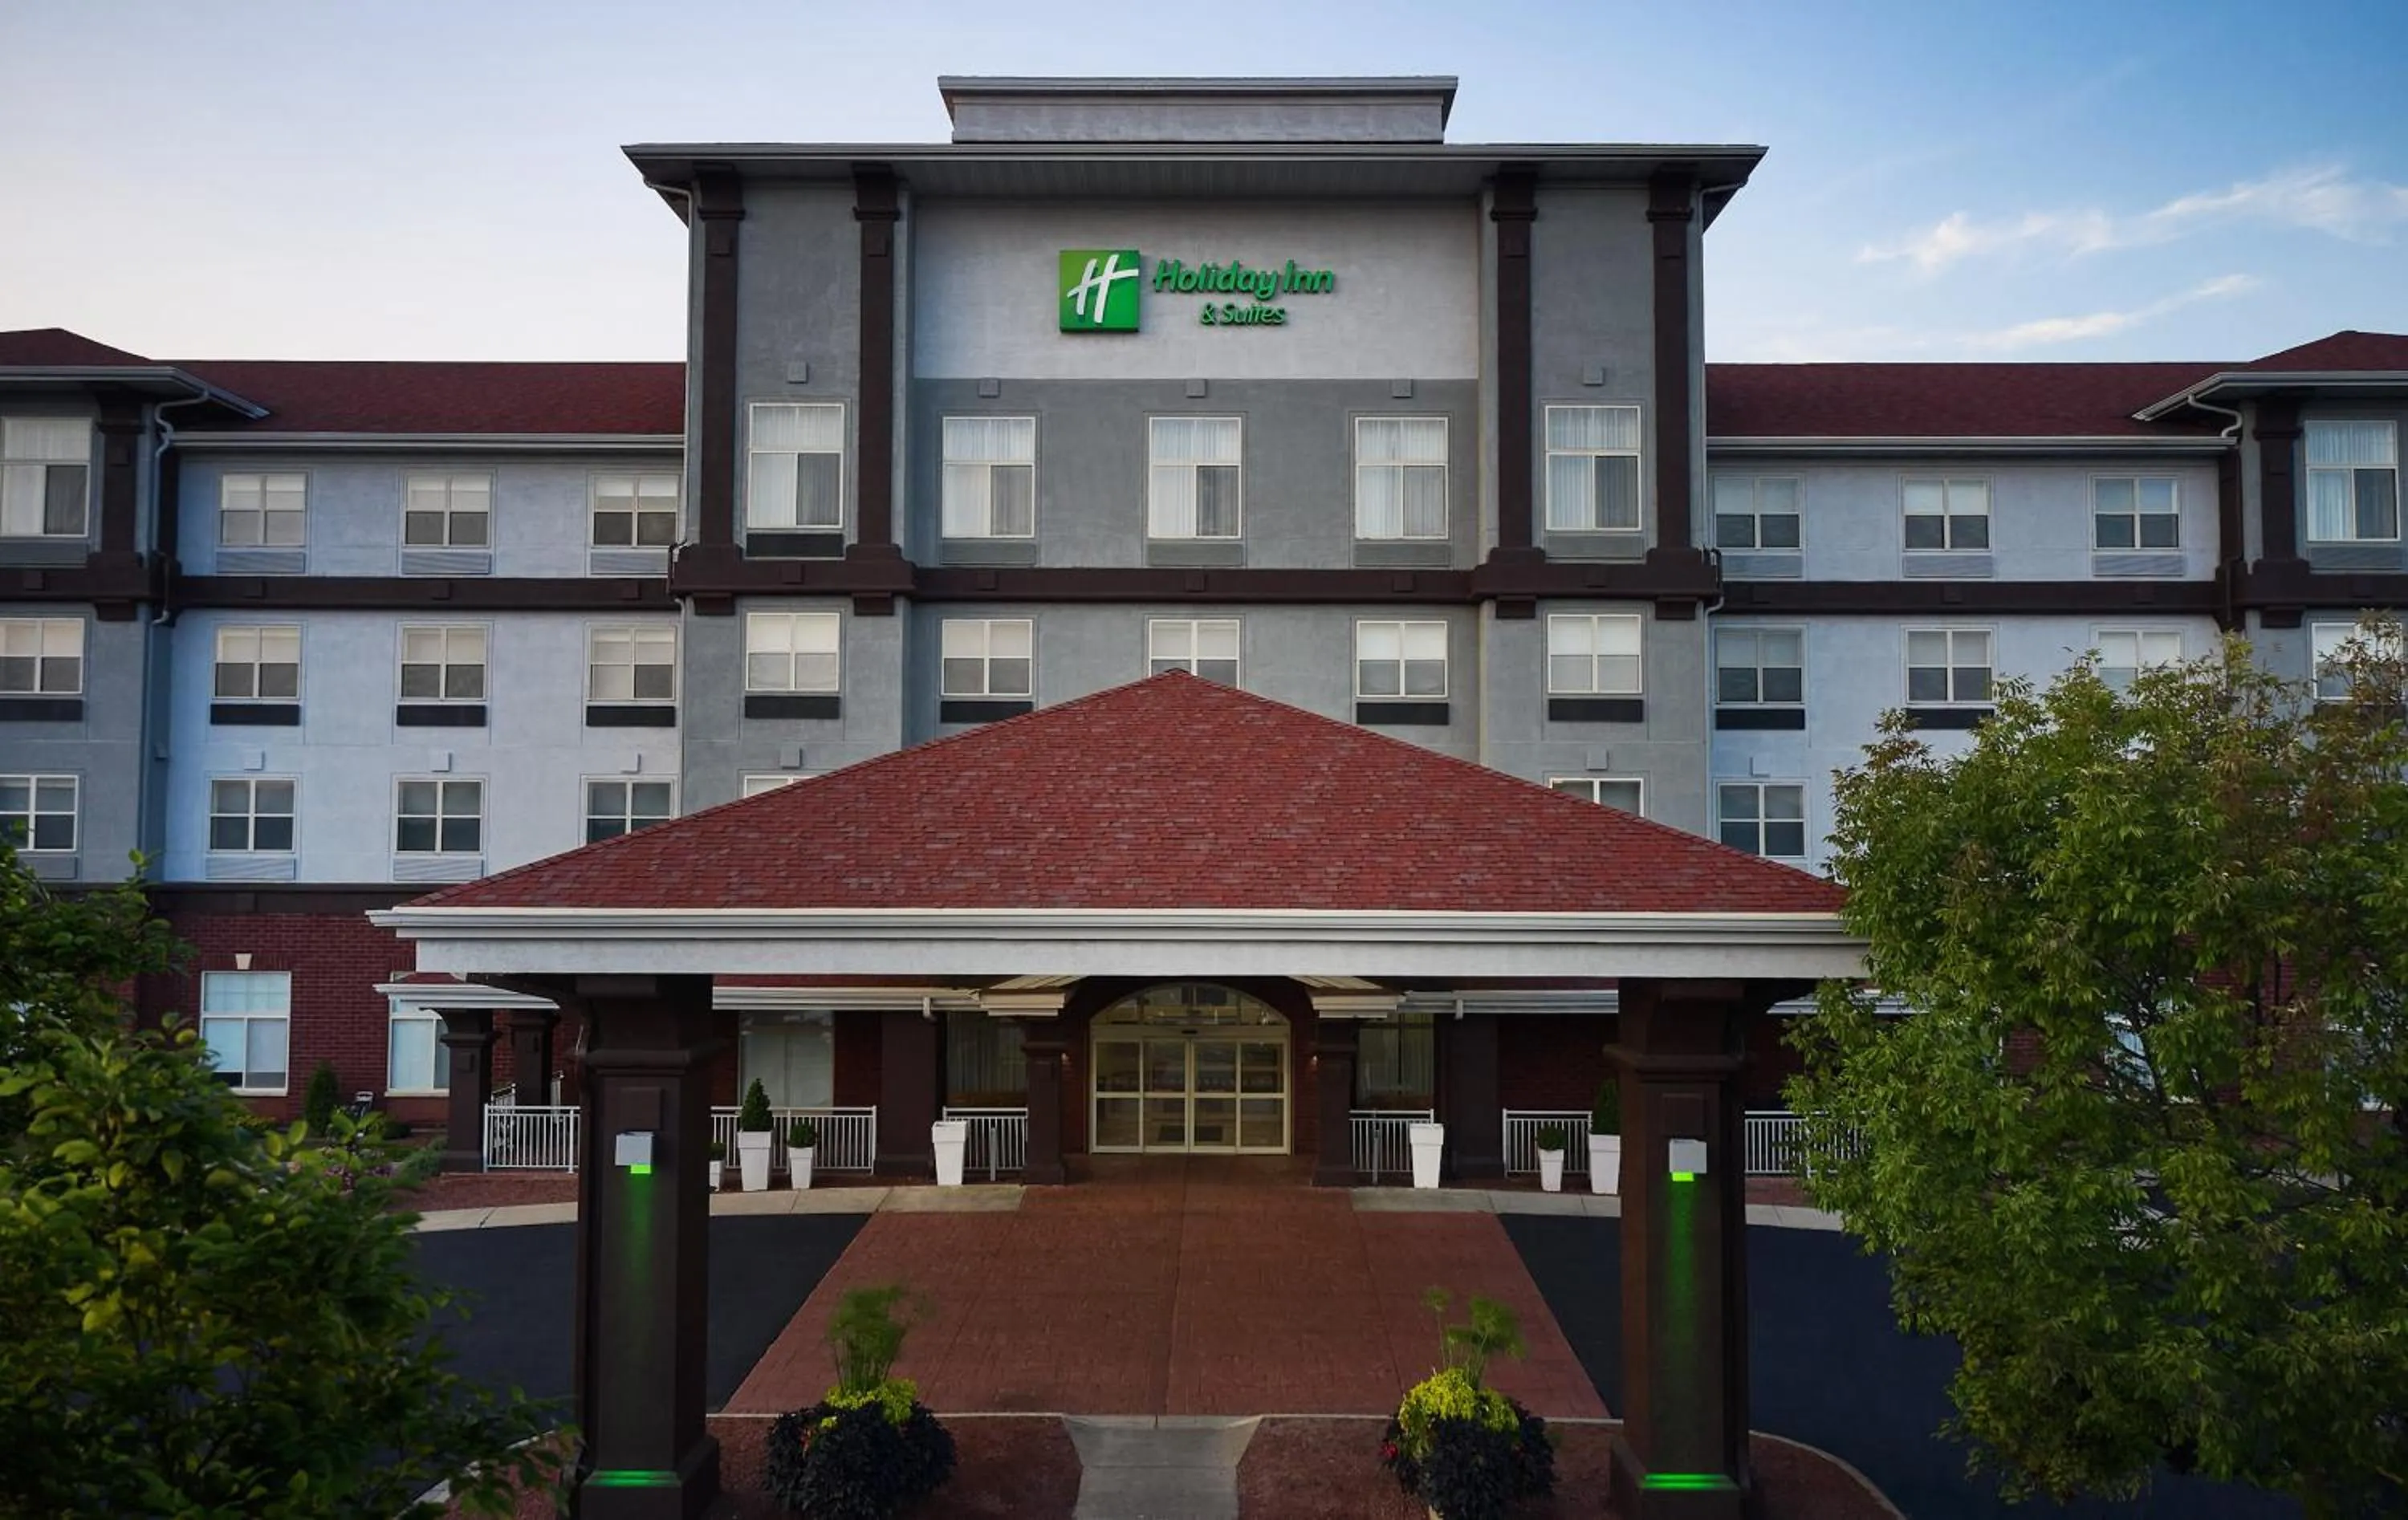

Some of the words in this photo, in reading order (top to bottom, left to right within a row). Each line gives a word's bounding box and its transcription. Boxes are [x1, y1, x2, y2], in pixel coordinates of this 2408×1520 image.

[1153, 258, 1279, 300] Holiday
[1282, 257, 1336, 294] Inn
[1200, 301, 1217, 325] &
[1219, 301, 1286, 326] Suites
